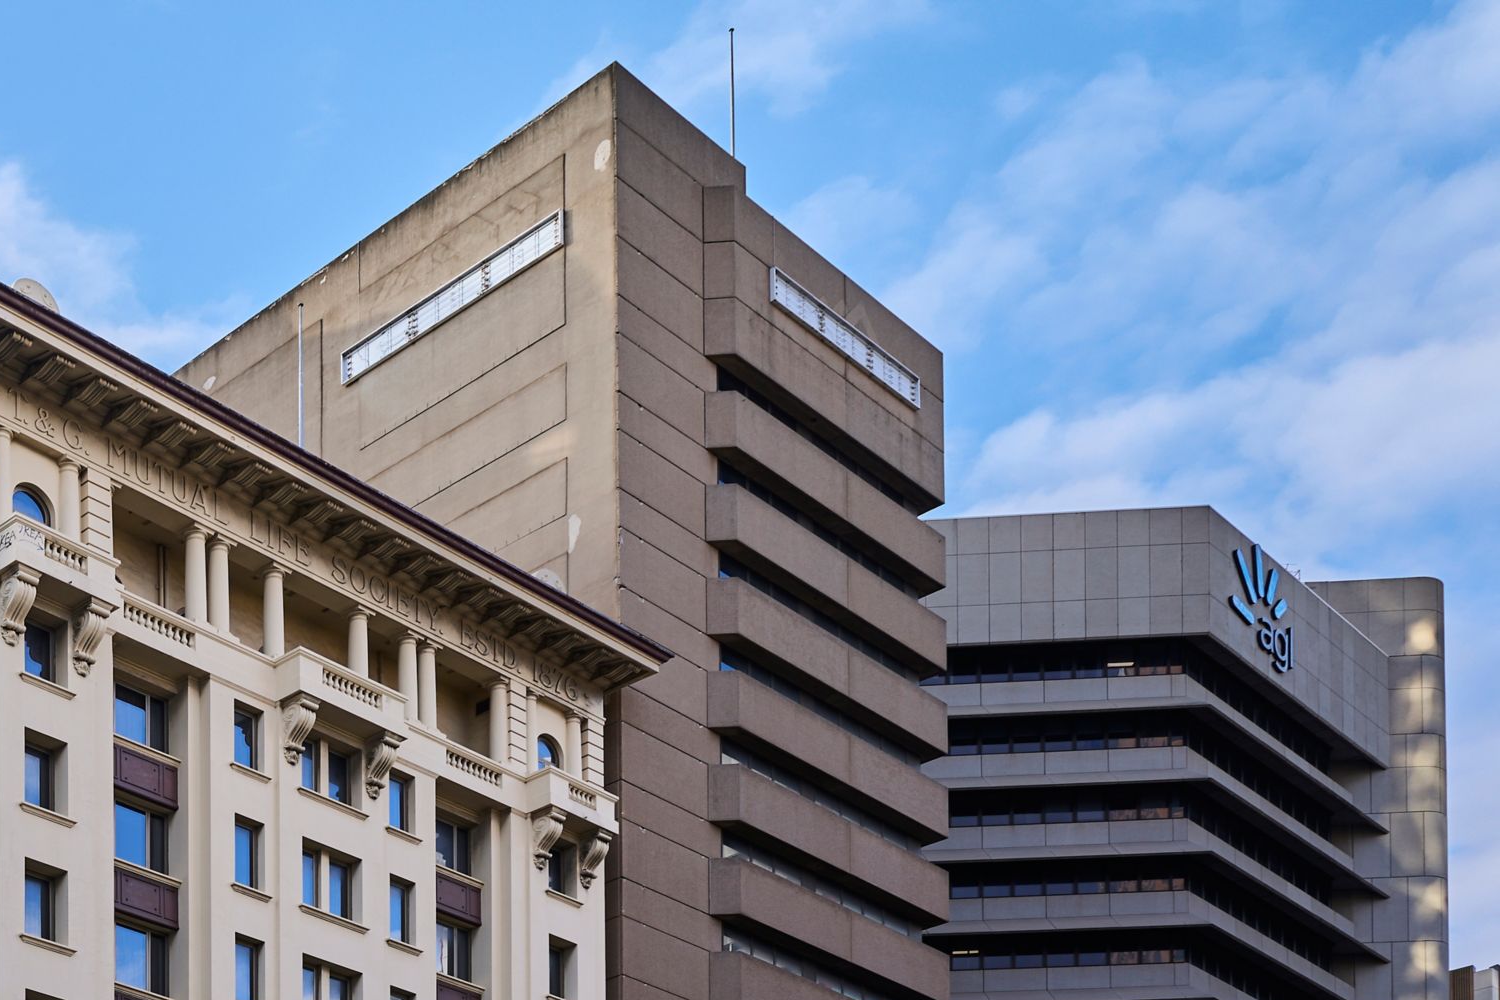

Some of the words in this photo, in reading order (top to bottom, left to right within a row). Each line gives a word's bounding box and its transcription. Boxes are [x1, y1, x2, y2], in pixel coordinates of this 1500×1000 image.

[34, 407, 54, 438] &
[106, 436, 229, 526] MUTUAL
[250, 509, 311, 567] LIFE
[532, 657, 579, 701] 1876
[1257, 617, 1294, 673] agl
